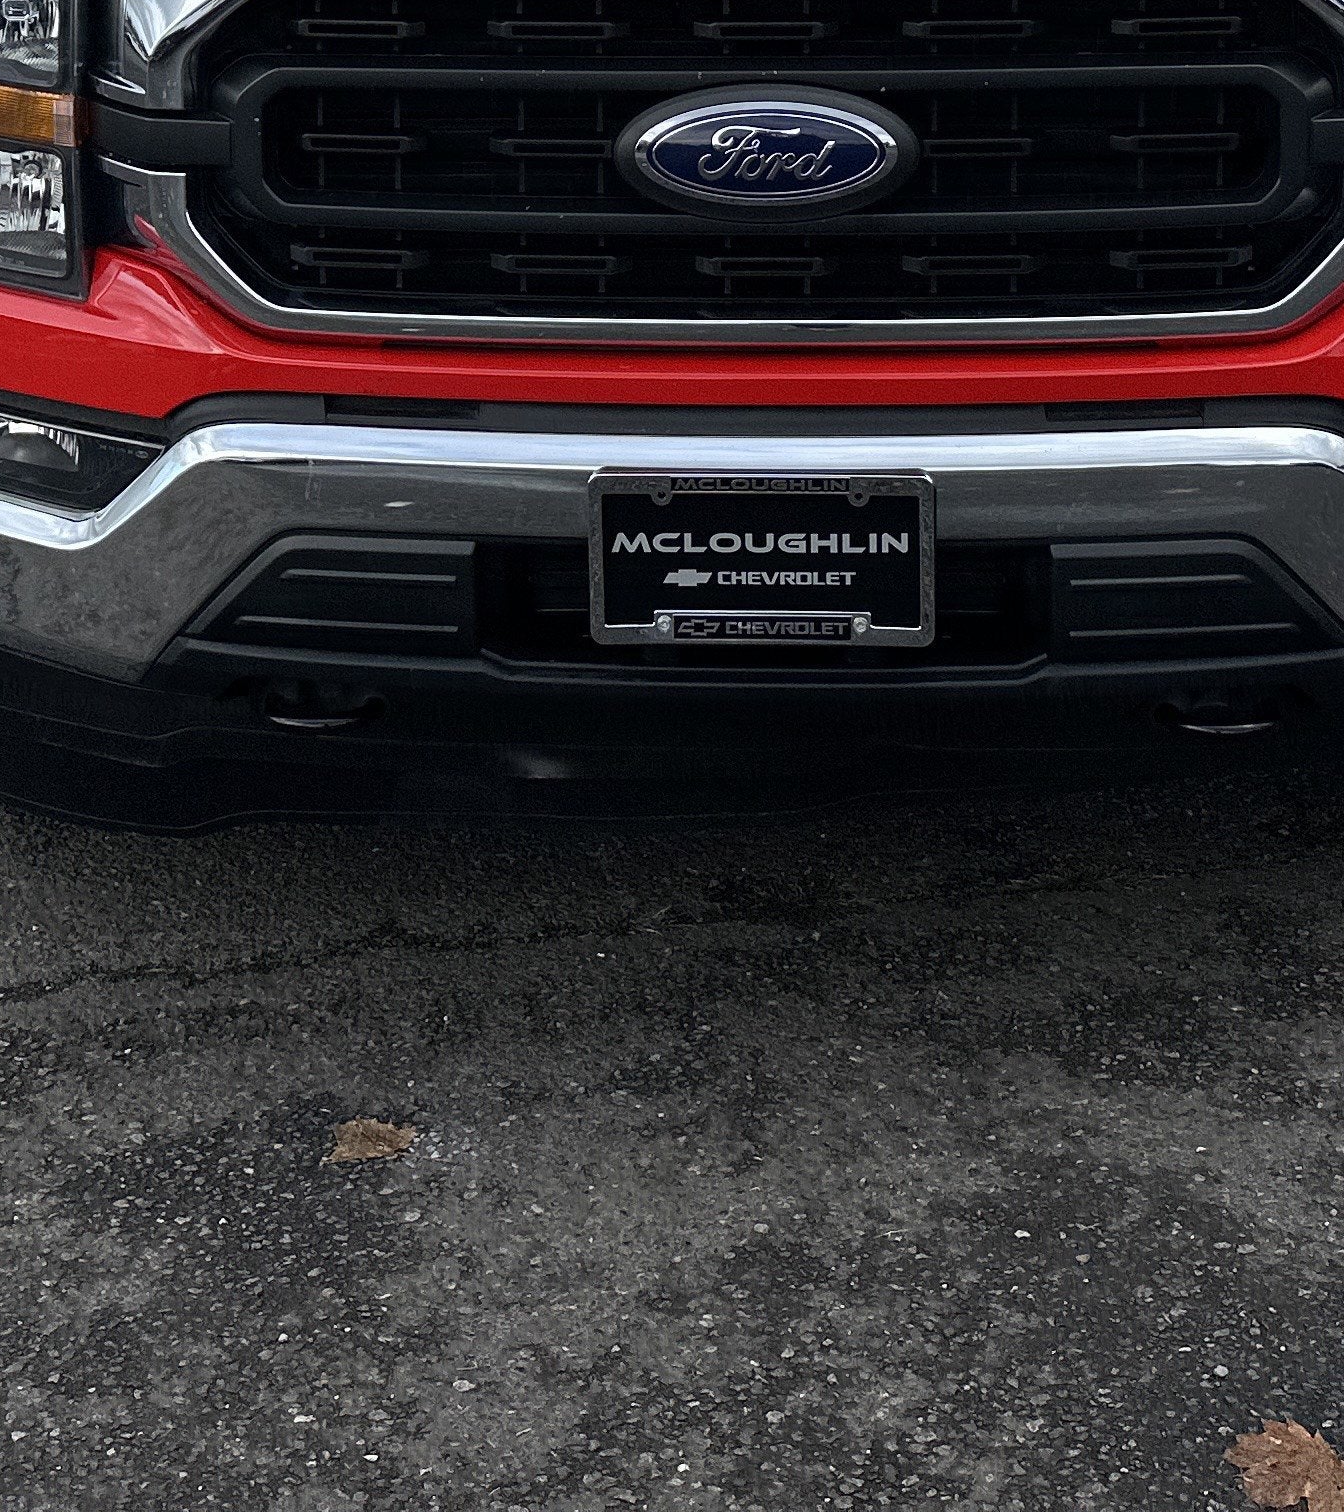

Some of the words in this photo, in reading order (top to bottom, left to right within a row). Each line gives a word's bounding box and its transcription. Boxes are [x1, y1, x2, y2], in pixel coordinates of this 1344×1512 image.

[698, 125, 836, 181] Ford
[674, 478, 848, 491] MCLOUGHLIN
[611, 533, 909, 554] MCLOUGHLIN
[717, 571, 857, 586] CHEVROLET
[725, 620, 849, 636] CHEVROLET
